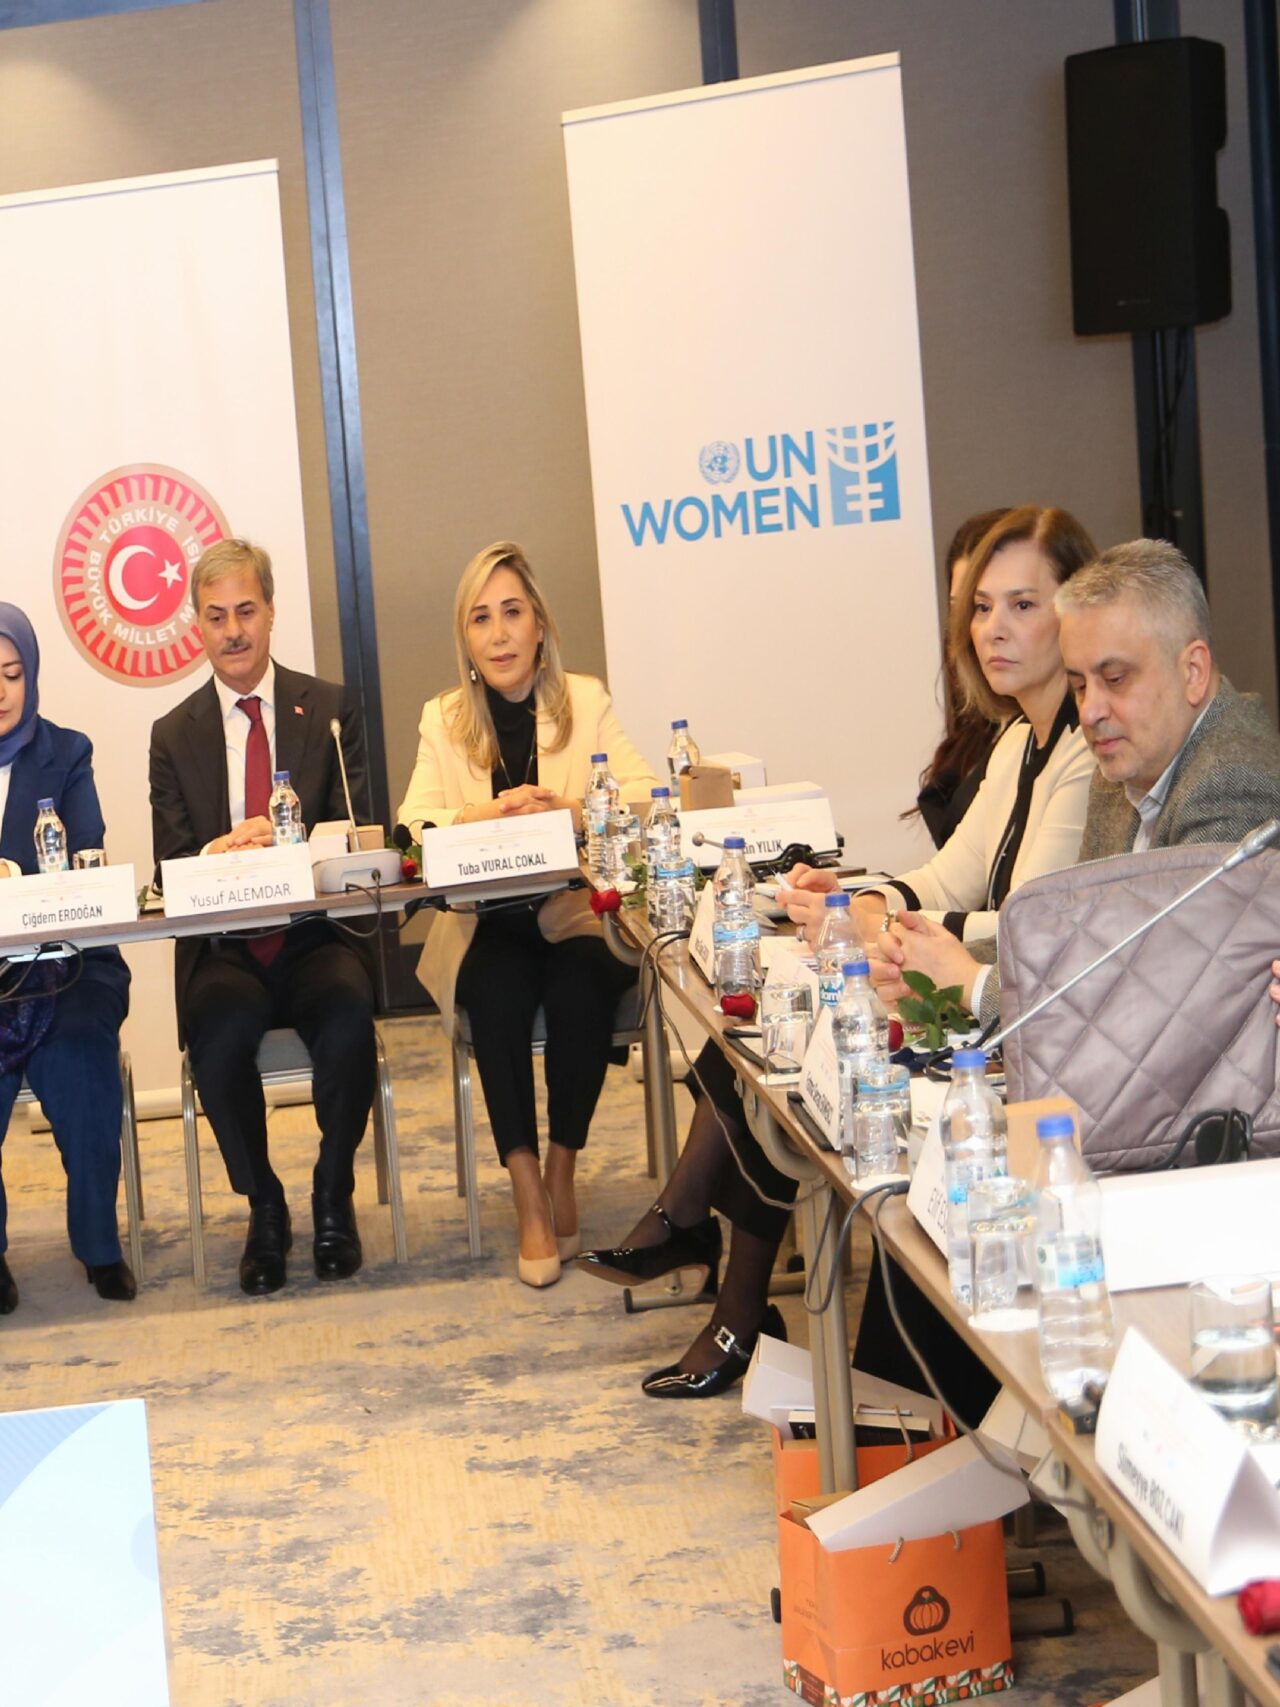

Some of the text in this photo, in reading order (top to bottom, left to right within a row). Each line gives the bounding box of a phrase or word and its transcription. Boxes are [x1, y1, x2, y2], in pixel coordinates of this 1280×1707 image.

[745, 431, 816, 482] UN
[99, 506, 179, 544] TÜRKİYE
[622, 483, 820, 547] WOMEN
[87, 551, 113, 625] BÜYÜK
[114, 623, 177, 646] MİLLET
[458, 863, 480, 876] Tuba
[481, 857, 513, 872] VURAL
[190, 882, 292, 908] Yusuf ALEMDAR
[22, 904, 103, 929] Çiğdem ERDOĞAN
[881, 1631, 975, 1671] kabakevi
